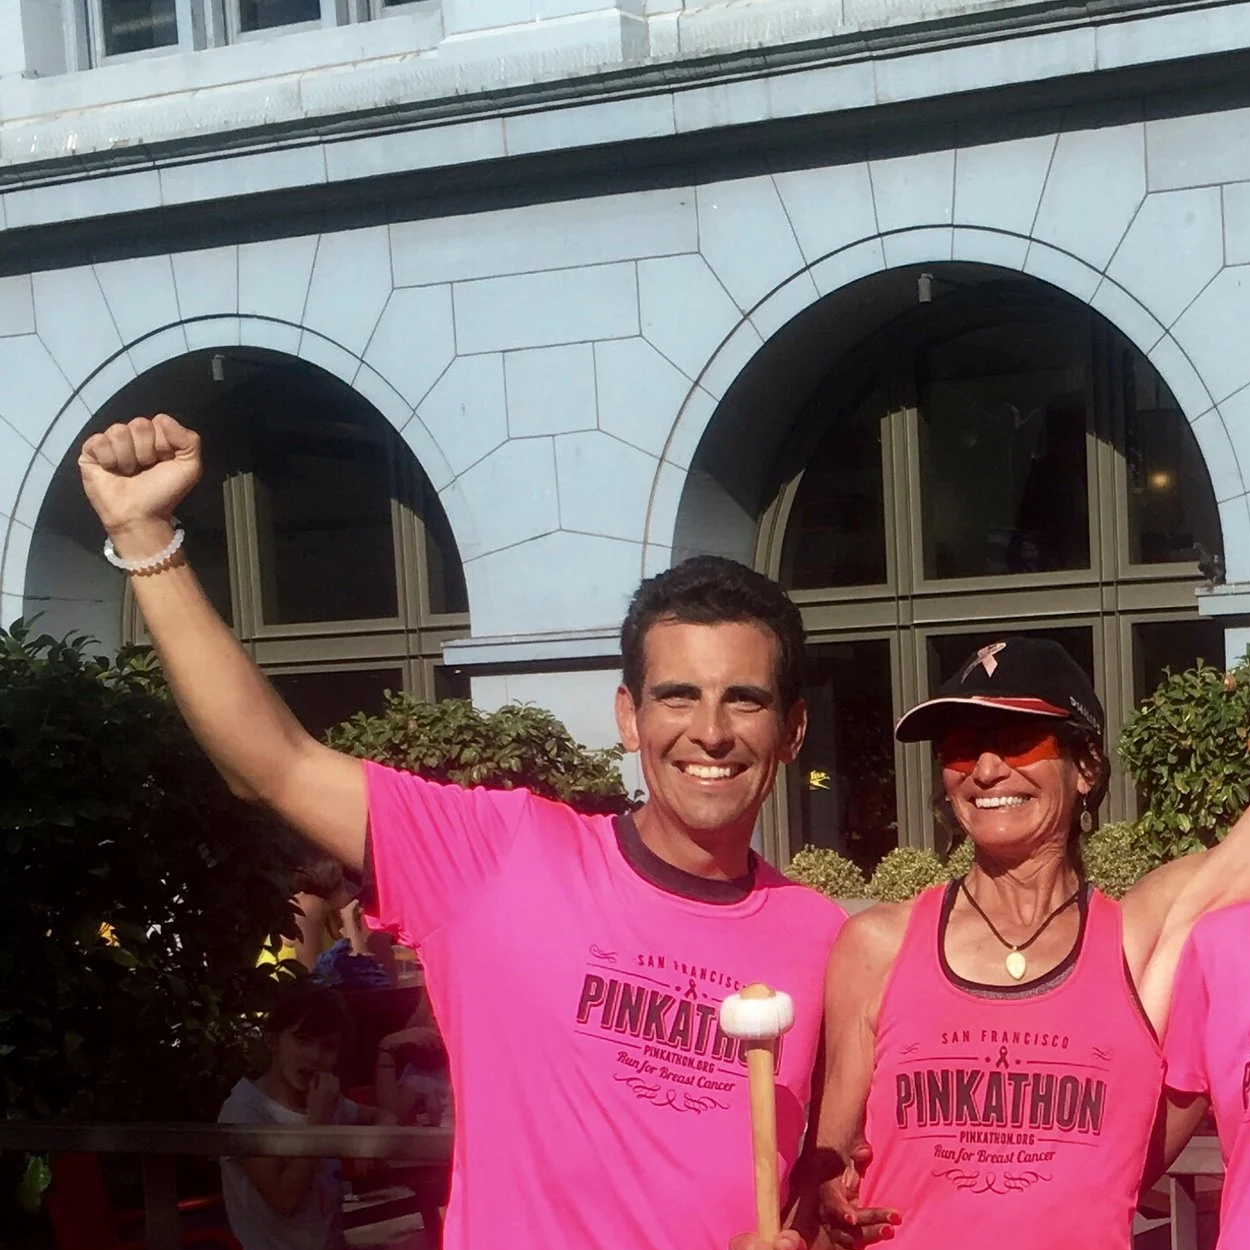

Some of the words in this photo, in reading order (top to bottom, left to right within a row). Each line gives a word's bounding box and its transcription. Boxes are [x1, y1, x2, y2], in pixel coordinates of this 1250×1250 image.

[637, 954, 665, 968] SAN
[673, 960, 746, 992] FRANCISC
[942, 1030, 970, 1045] SAN
[981, 1029, 1069, 1049] FRANCISCO
[616, 1051, 639, 1068] Run
[636, 1057, 658, 1076] for
[659, 1066, 696, 1086] Breast
[697, 1076, 736, 1092] Cancer
[643, 1045, 716, 1074] PINKATHON.ORG
[896, 1069, 1107, 1136] PINKATHON
[959, 1131, 1035, 1146] PINKATHON.ORG
[934, 1144, 955, 1160] Run
[953, 1148, 974, 1164] for
[977, 1150, 1015, 1164] Breast
[1017, 1150, 1056, 1163] Cancer
